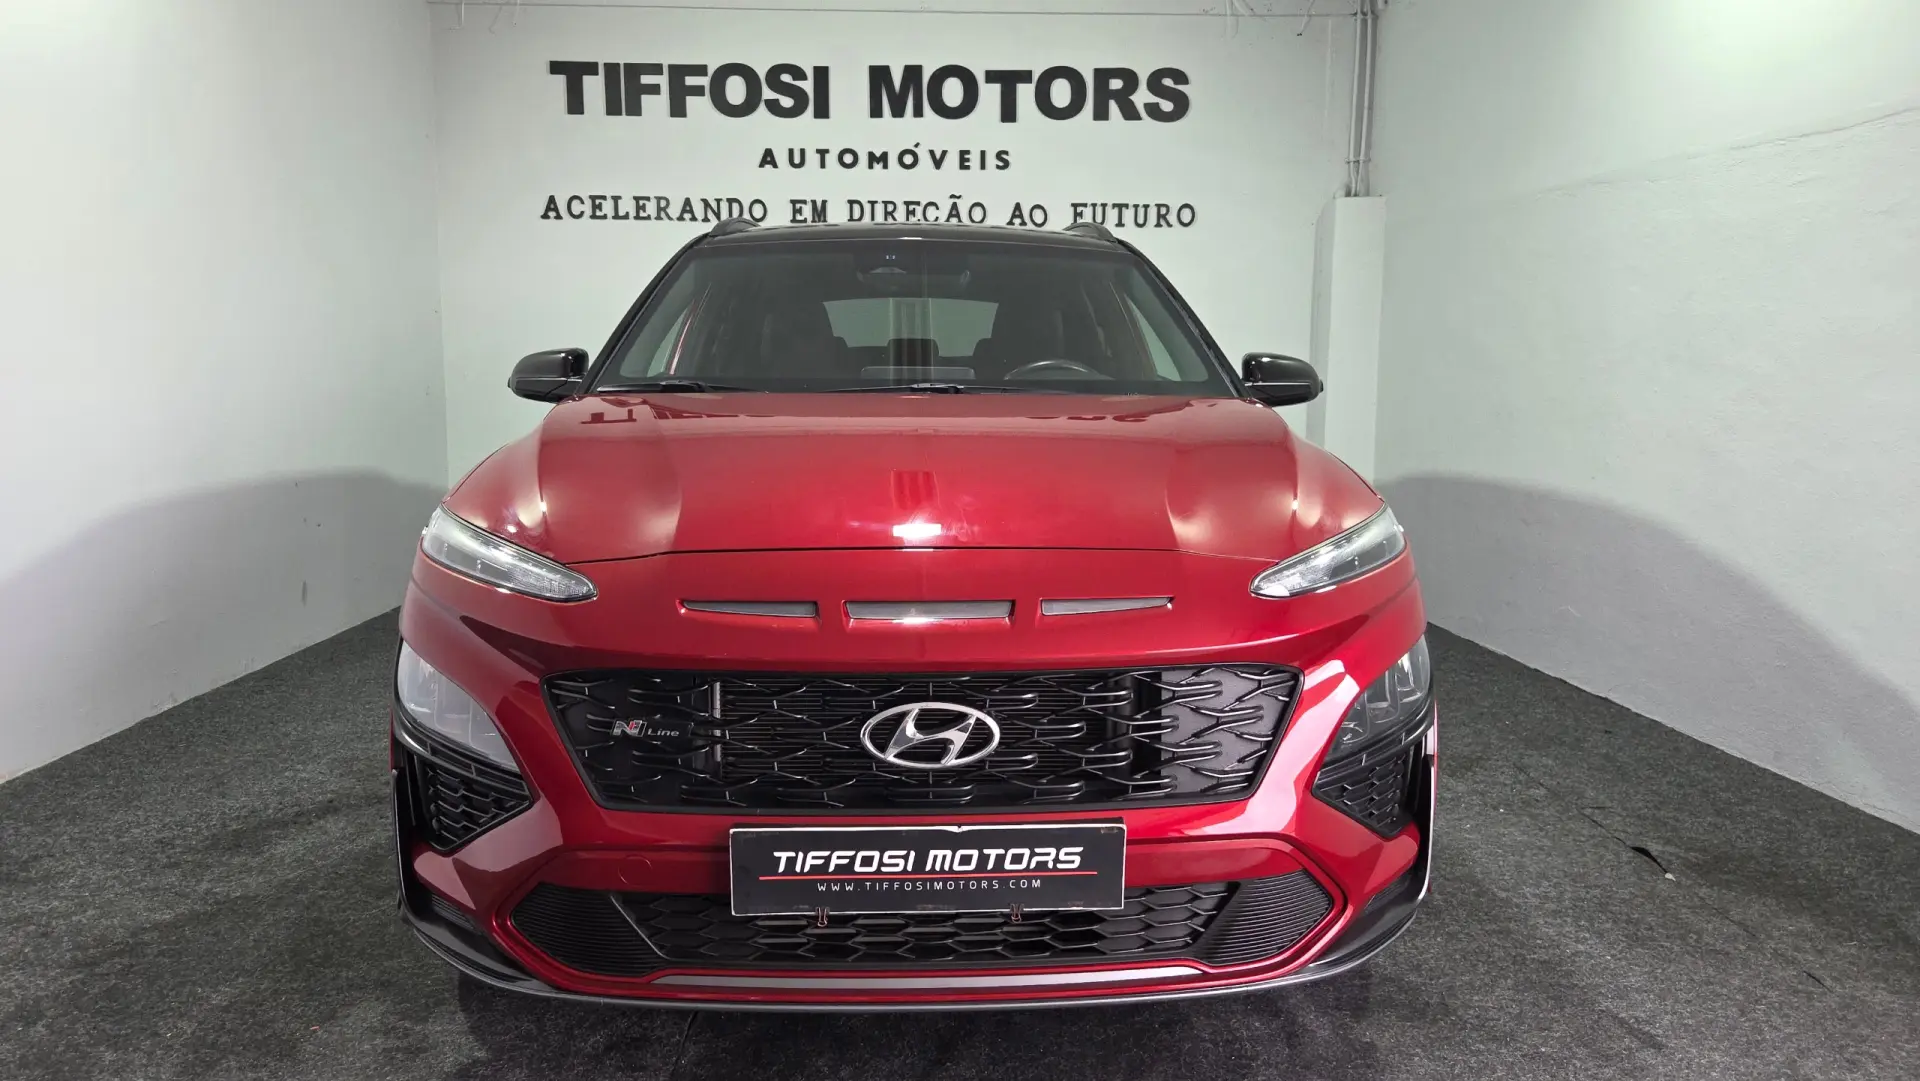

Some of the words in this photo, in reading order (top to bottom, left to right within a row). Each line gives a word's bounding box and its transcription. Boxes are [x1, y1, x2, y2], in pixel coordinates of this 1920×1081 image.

[549, 60, 830, 120] TIFFOSI
[869, 64, 1190, 124] MOTORS
[758, 142, 1011, 171] AUTOMÓVEIS
[540, 194, 767, 223] ACELERANDO
[789, 199, 828, 224] EM
[1006, 202, 1048, 228] AO
[1070, 202, 1196, 229] FUTURO
[647, 727, 680, 737] Line
[773, 849, 916, 874] TIFFOSI
[925, 846, 1084, 872] MOTORS
